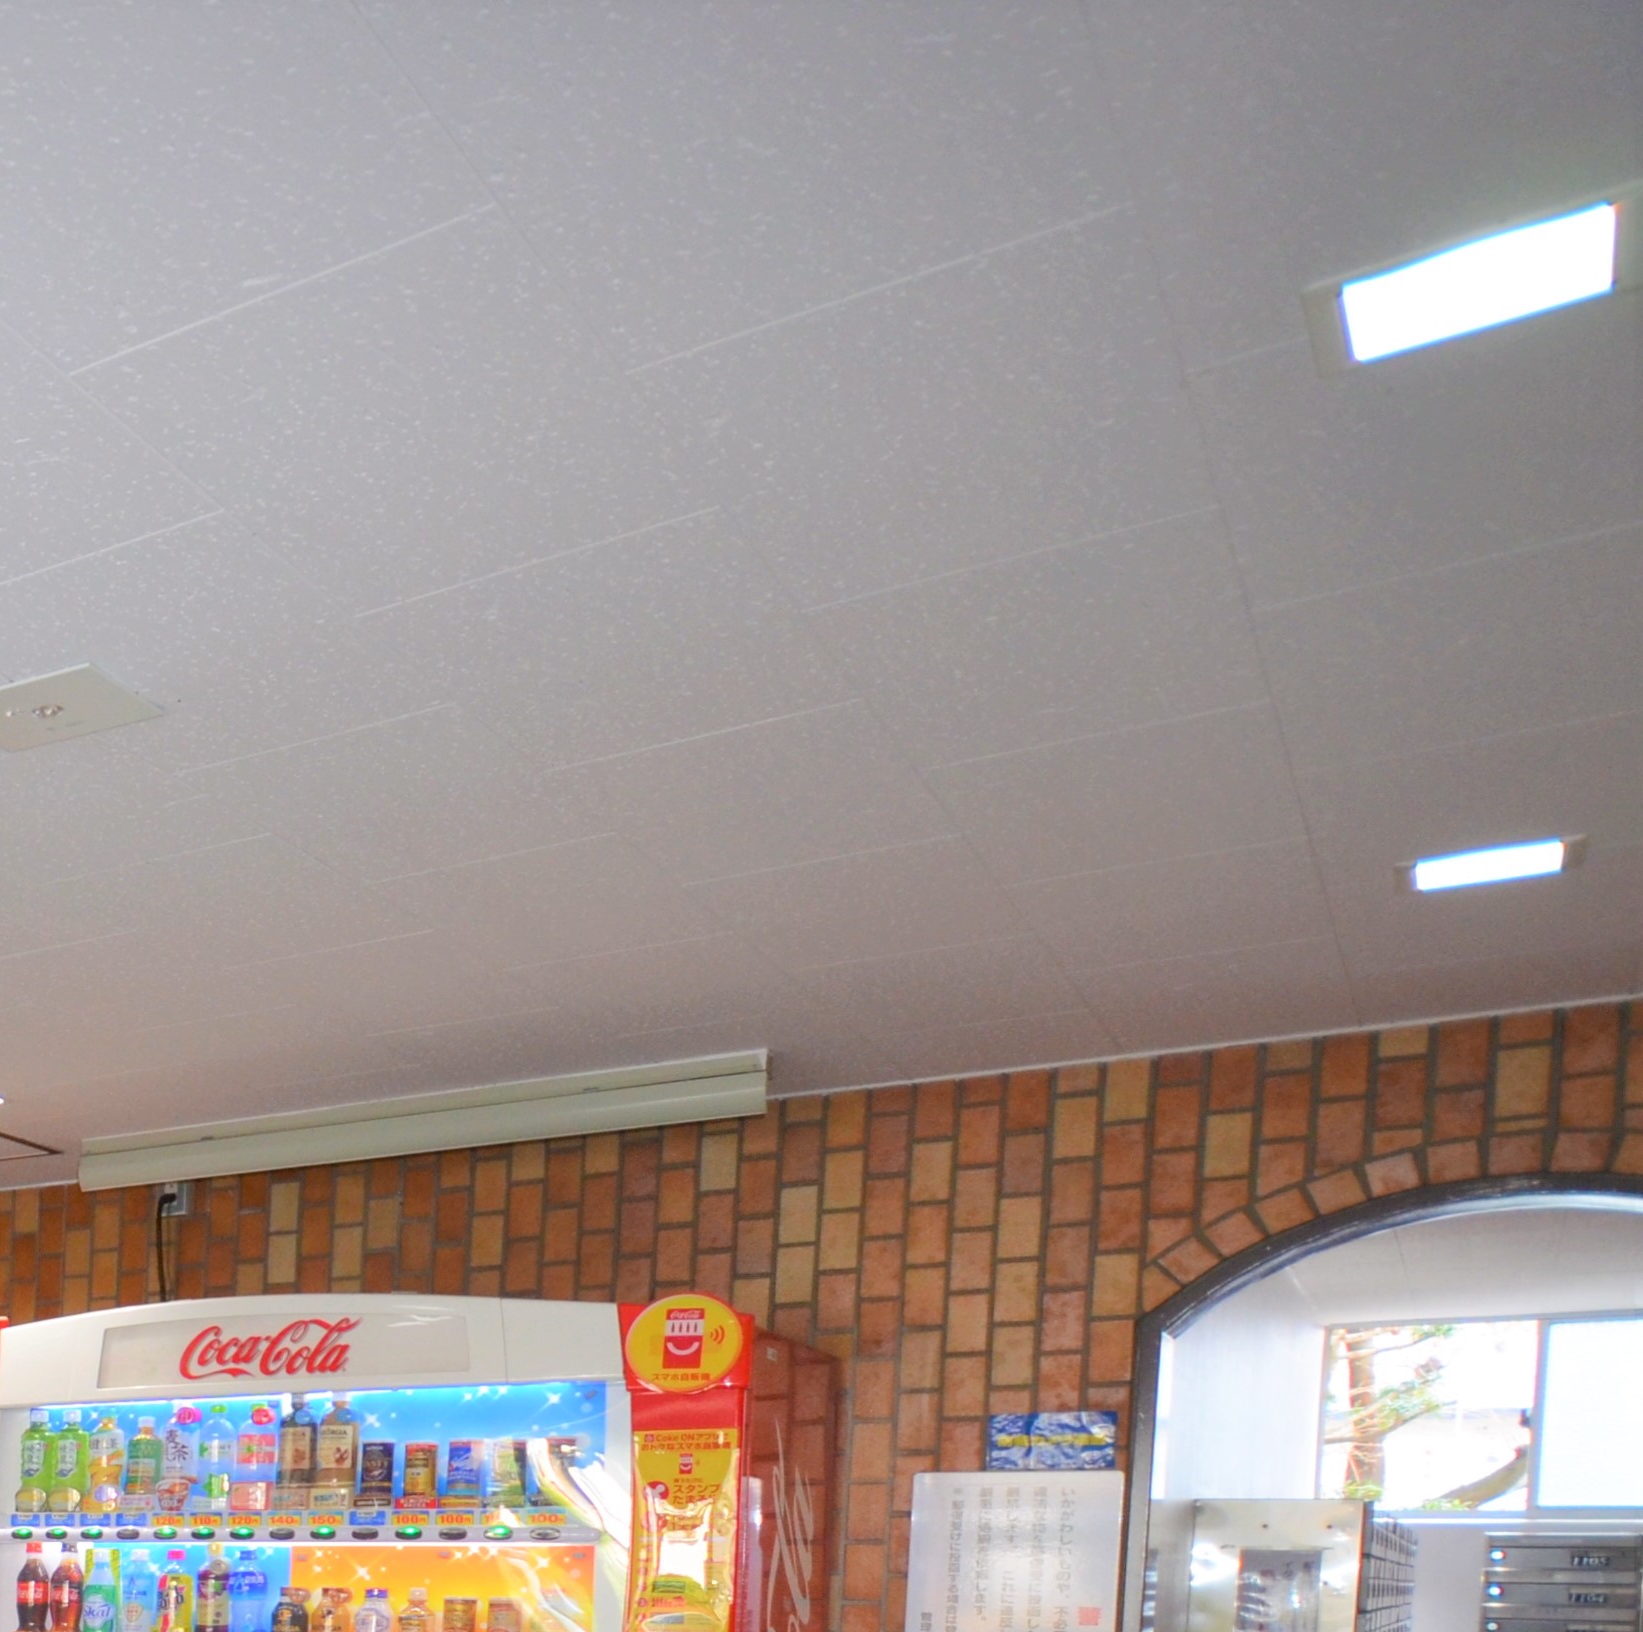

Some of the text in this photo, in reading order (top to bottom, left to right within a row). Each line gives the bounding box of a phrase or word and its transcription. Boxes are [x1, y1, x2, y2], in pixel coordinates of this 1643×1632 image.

[179, 1317, 363, 1380] Coca-Cola
[674, 1484, 721, 1495] スタンプ
[1572, 1556, 1607, 1566] 1105
